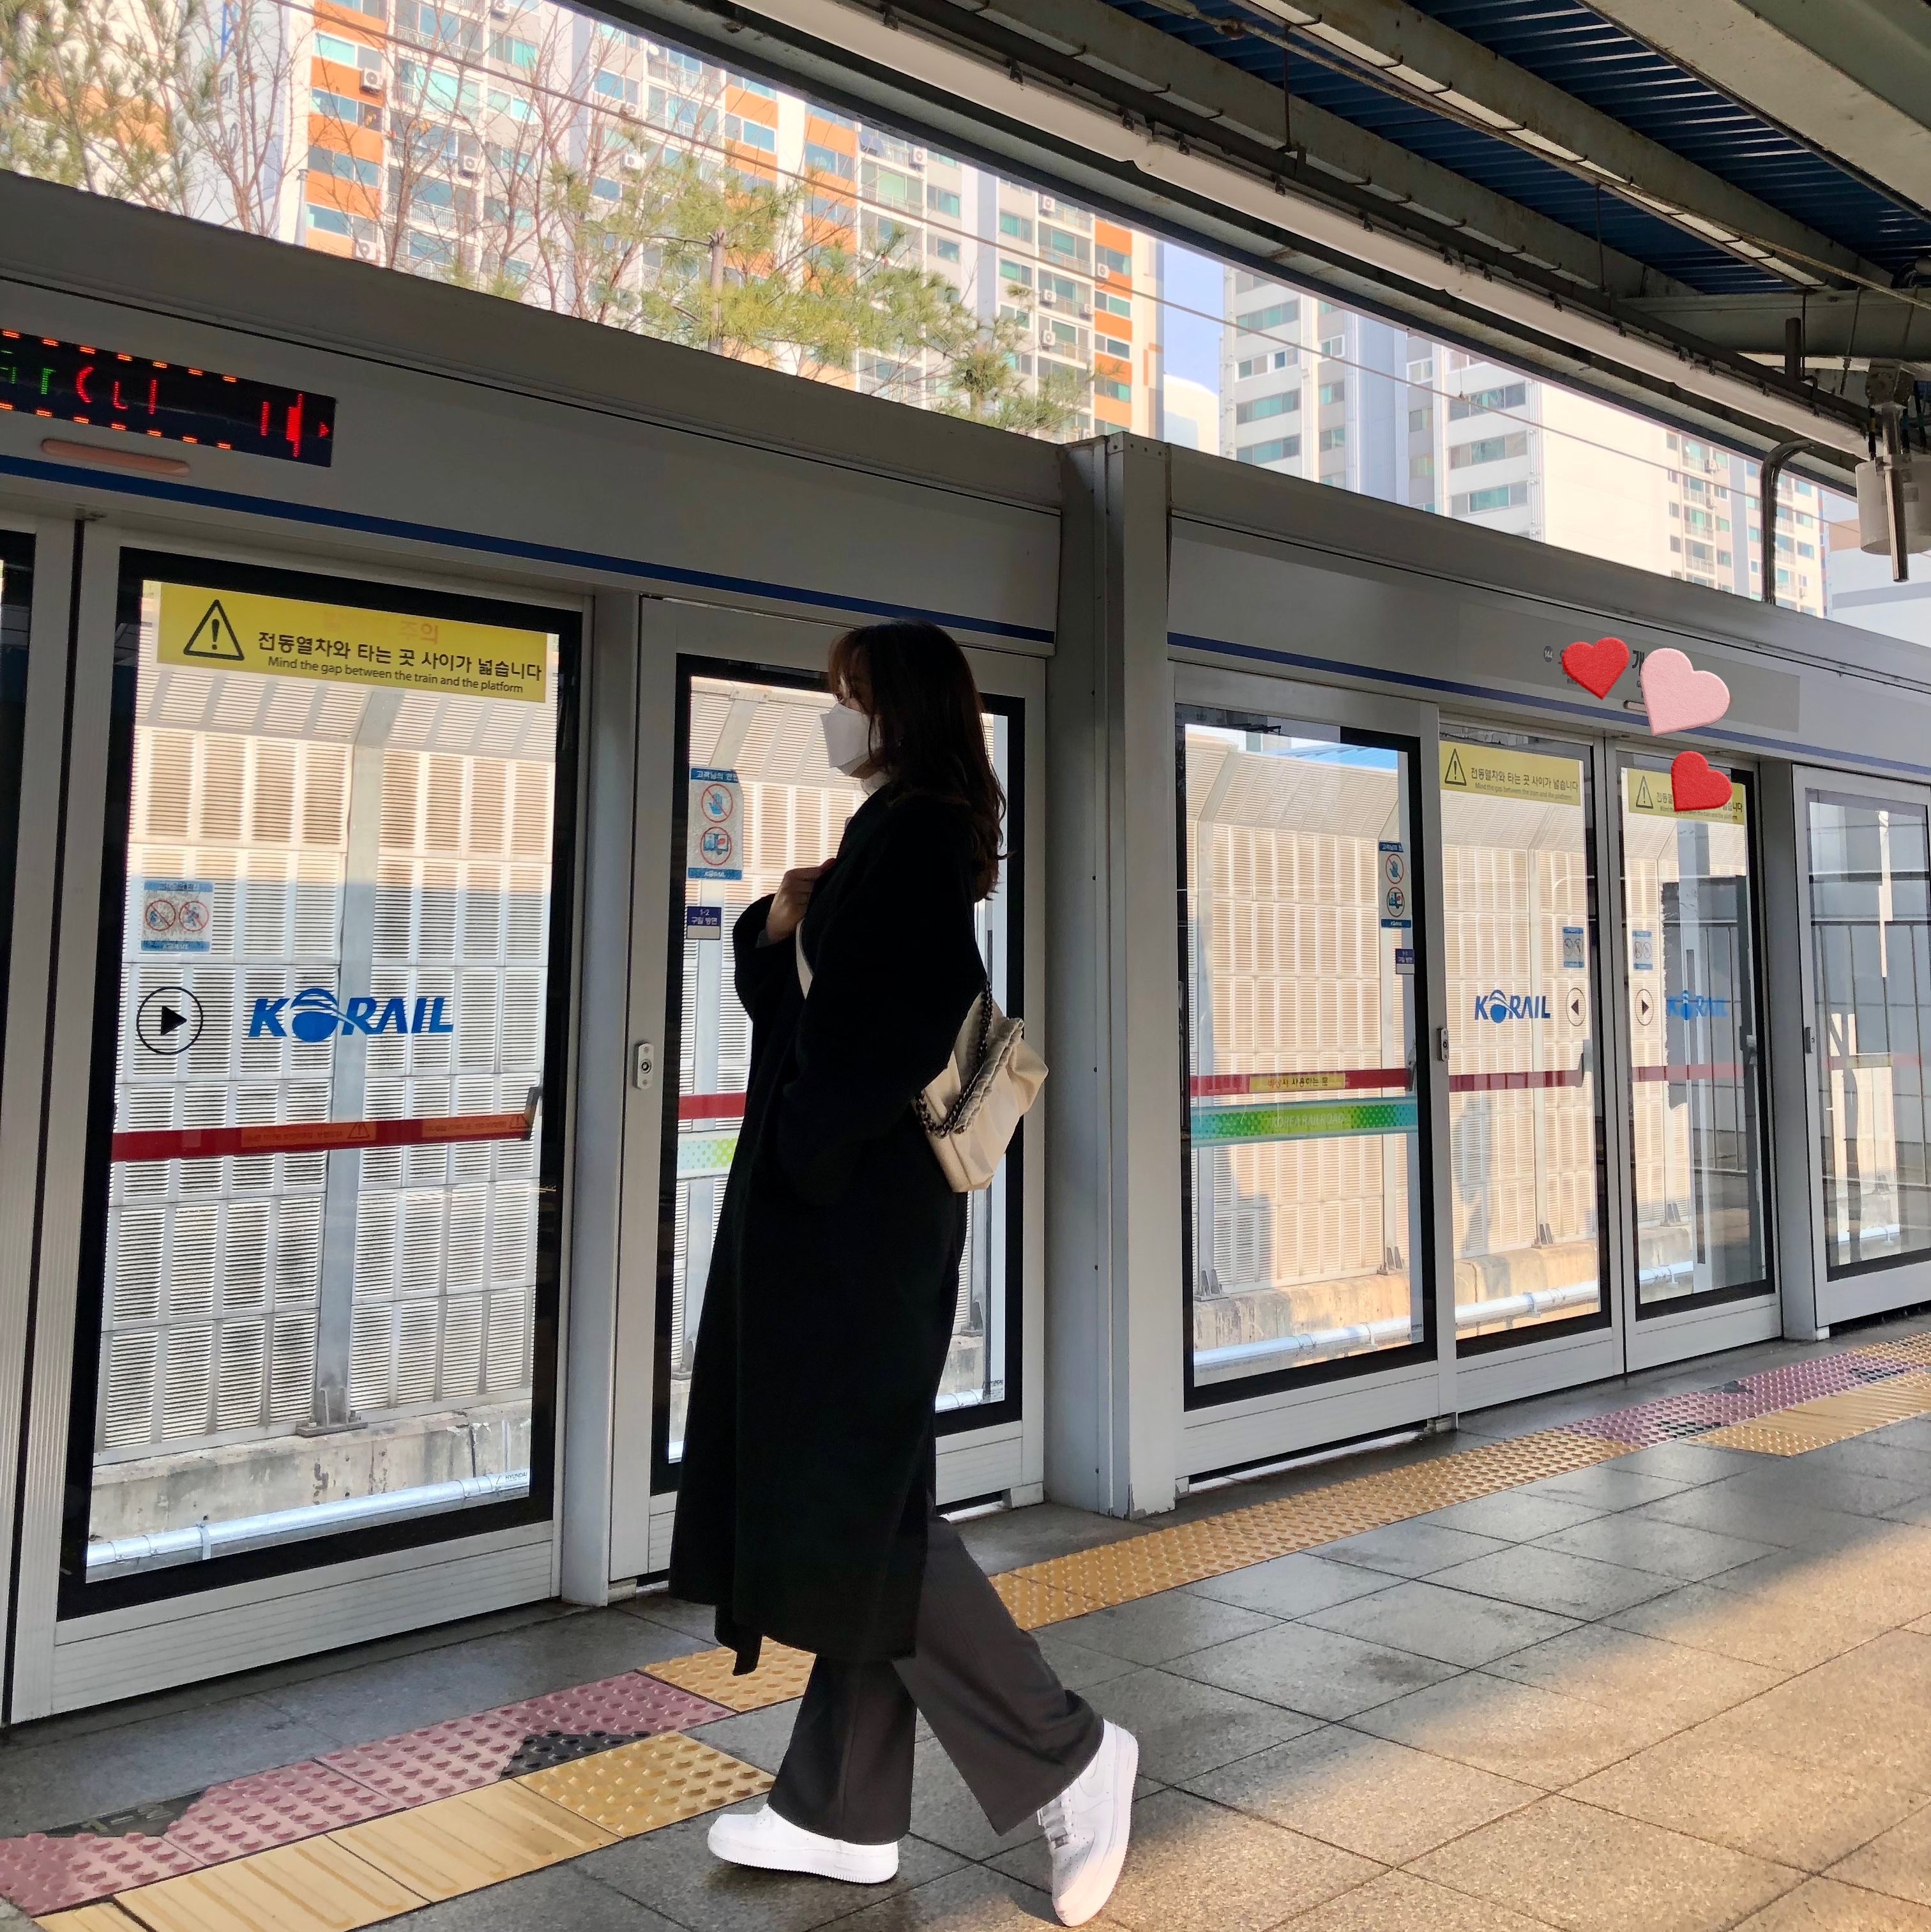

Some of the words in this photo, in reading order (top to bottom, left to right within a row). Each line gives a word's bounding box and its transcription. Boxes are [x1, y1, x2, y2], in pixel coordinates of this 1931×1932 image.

[258, 632, 351, 659] 전동열차와
[358, 644, 391, 664] 타는
[399, 648, 415, 667] 곳
[421, 651, 472, 673] 사이가
[478, 658, 542, 681] 넓습니다
[268, 656, 297, 669] Mind
[300, 660, 319, 671] the
[321, 663, 342, 675] gap
[345, 664, 391, 679] between
[395, 671, 412, 681] the
[414, 673, 437, 684] train
[441, 676, 459, 686] and
[462, 678, 478, 688] the
[481, 681, 523, 694] platform
[1471, 767, 1505, 782] 전동열차와
[1508, 772, 1520, 785] 타는
[1523, 774, 1529, 786] 곳
[1531, 776, 1551, 789] 사이가
[1553, 779, 1579, 792] 넓습니다
[248, 988, 453, 1042] KORAIL
[1474, 989, 1550, 1023] KORAIL
[1292, 1077, 1319, 1088] 사용하는
[1322, 1077, 1328, 1086] 문
